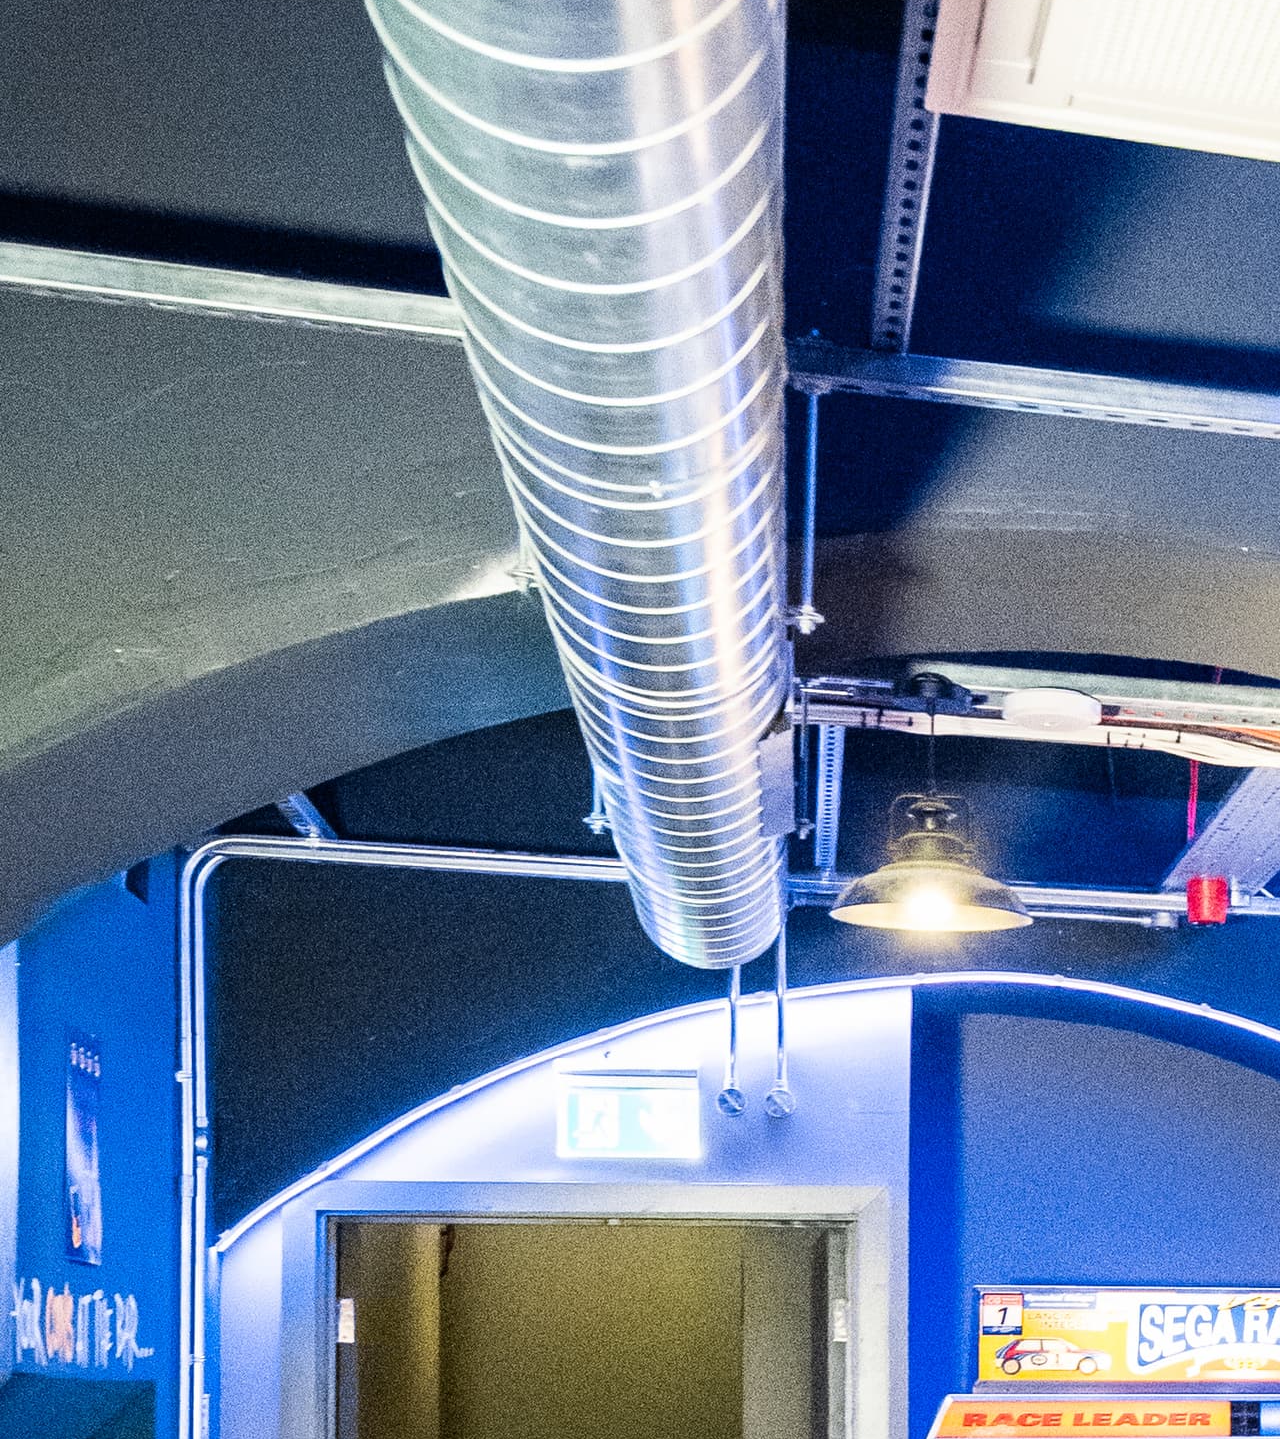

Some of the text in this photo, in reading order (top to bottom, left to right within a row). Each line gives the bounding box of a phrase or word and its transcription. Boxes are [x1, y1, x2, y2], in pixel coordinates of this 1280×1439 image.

[1139, 1304, 1238, 1363] SEGA
[962, 1412, 1210, 1427] RACE LEADER
